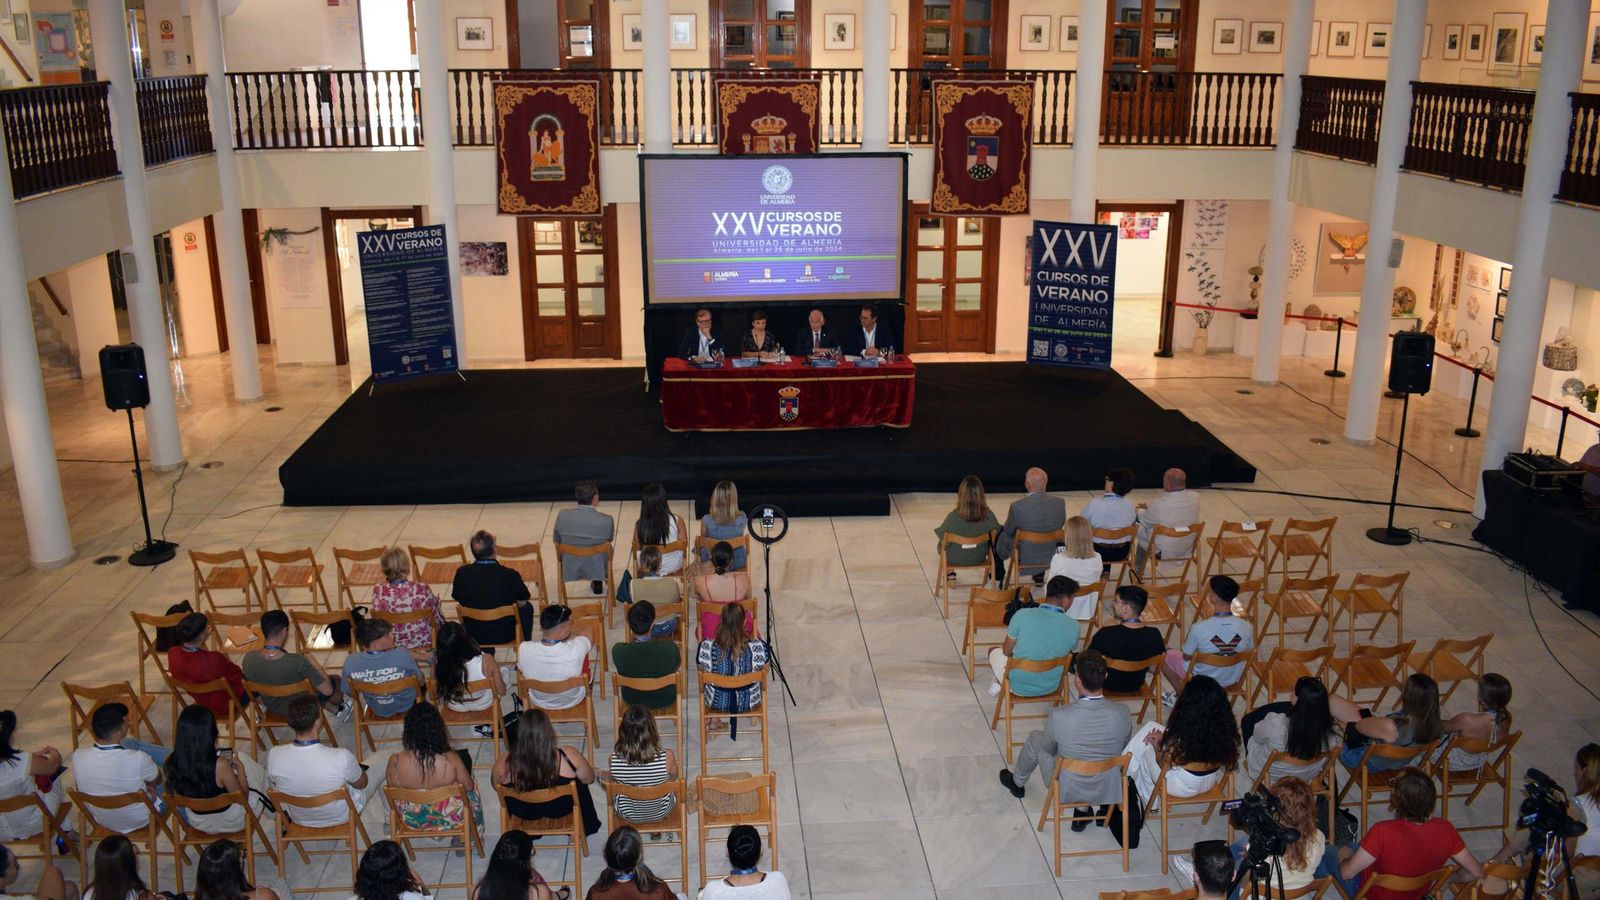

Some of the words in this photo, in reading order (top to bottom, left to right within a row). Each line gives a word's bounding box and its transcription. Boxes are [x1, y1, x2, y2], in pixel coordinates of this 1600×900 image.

[766, 211, 822, 222] CURSOS
[823, 211, 842, 221] DE
[712, 212, 765, 236] XXV
[767, 223, 842, 236] VERANO
[396, 230, 429, 240] CURSOS
[362, 234, 395, 254] XXV
[396, 237, 443, 250] VERANO
[712, 239, 779, 247] UNIVERSIDAD
[1039, 228, 1112, 269] XXV
[1037, 271, 1088, 285] CURSOS
[1091, 275, 1110, 286] DE
[1037, 285, 1109, 303] VERANO
[1035, 302, 1108, 316] UNIVERSIDAD
[1034, 315, 1049, 324] DE
[1057, 317, 1107, 329] ALMERÍA
[351, 669, 375, 680] WAIT
[376, 667, 398, 676] FOR
